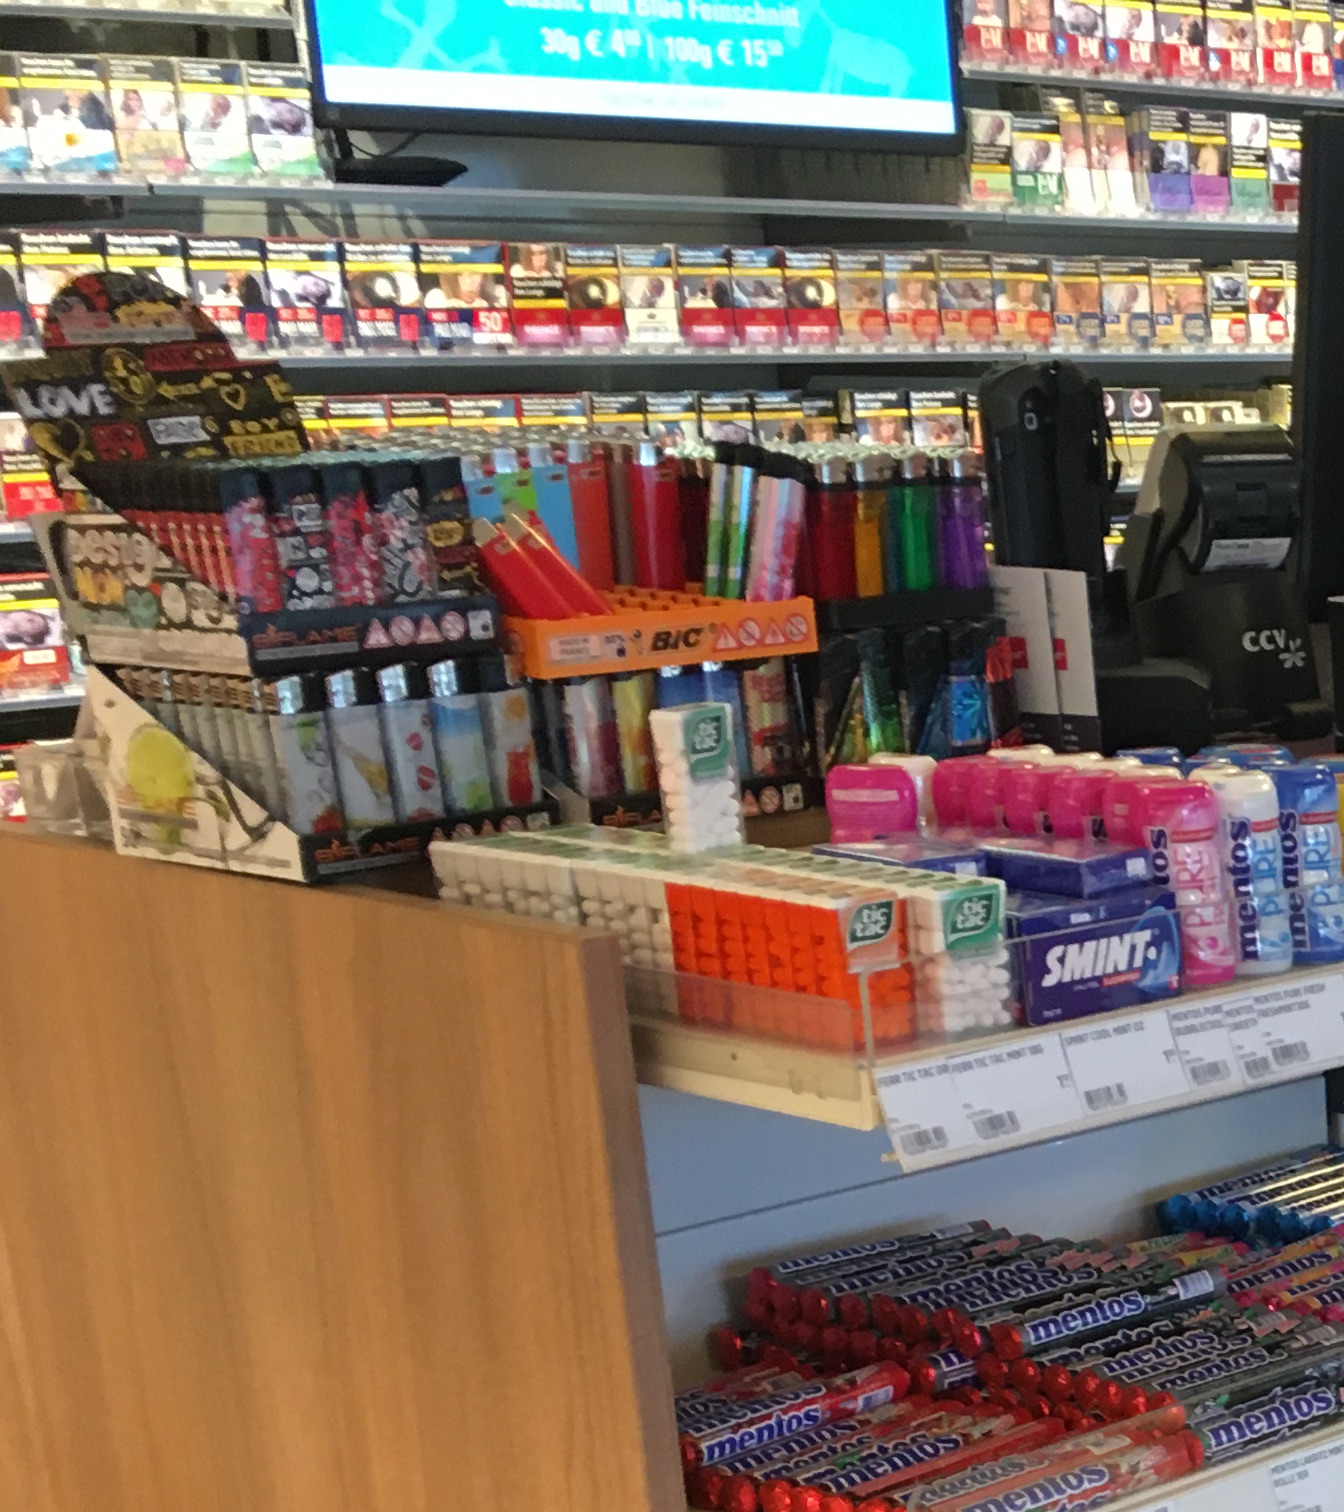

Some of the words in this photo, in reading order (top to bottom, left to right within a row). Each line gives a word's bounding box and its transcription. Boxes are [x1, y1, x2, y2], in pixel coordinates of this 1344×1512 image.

[540, 27, 581, 61] 30g
[584, 29, 604, 58] €
[665, 36, 713, 69] 100g
[717, 39, 735, 66] €
[16, 382, 117, 419] LOVE
[962, 896, 989, 914] tic
[1227, 819, 1260, 961] mentos
[855, 918, 889, 937] tac
[863, 904, 888, 922] tic
[956, 911, 988, 930] tac
[1227, 1250, 1336, 1294] mentos
[1029, 1290, 1145, 1347] mentos
[703, 1405, 823, 1465] mentos
[1208, 1386, 1335, 1450] mentos
[829, 1433, 963, 1493] mentos
